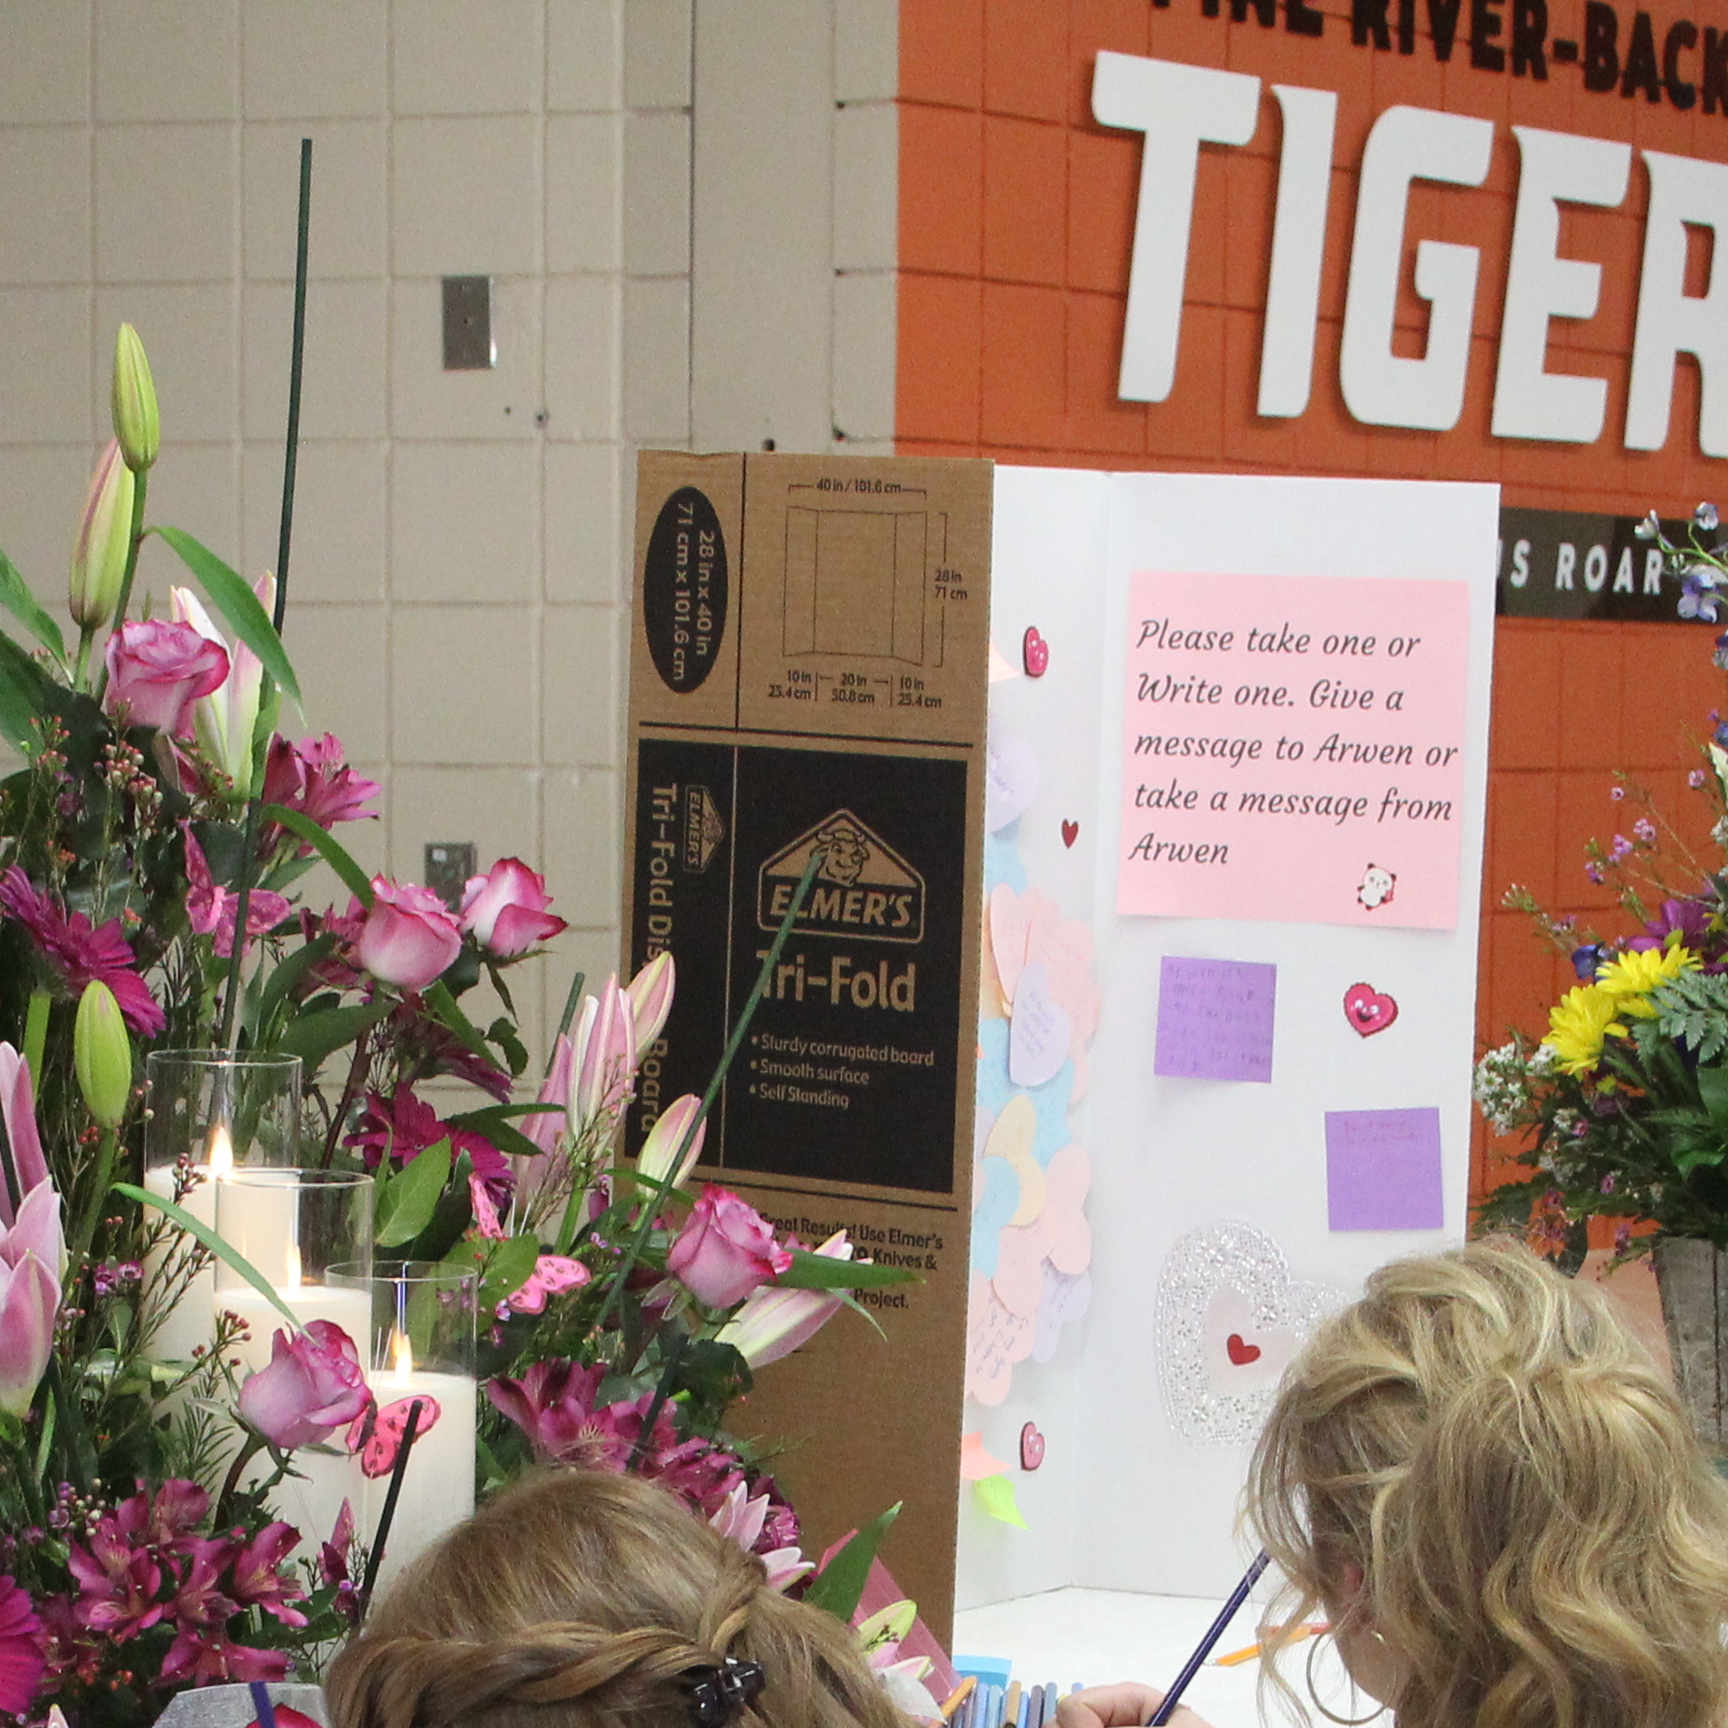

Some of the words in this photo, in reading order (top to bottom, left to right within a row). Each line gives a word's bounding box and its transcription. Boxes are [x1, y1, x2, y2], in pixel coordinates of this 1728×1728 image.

[677, 502, 695, 524] 71
[676, 532, 690, 565] cm
[698, 530, 715, 558] 28
[698, 561, 714, 581] in
[1496, 538, 1532, 588] S
[673, 588, 692, 644] 101.6
[696, 602, 713, 632] 40
[696, 634, 712, 656] in
[1136, 618, 1234, 651] Please
[1246, 622, 1311, 654] take
[1322, 632, 1376, 656] one
[1387, 635, 1421, 658] or
[673, 647, 686, 680] cm
[1137, 672, 1223, 704] Write
[1234, 682, 1295, 708] one.
[1309, 679, 1374, 710] Give
[1385, 688, 1404, 712] a
[1134, 732, 1263, 768] message
[1275, 736, 1305, 761] to
[1313, 733, 1413, 766] Arwen
[1424, 745, 1459, 769] or
[1134, 777, 1198, 810] take
[1209, 788, 1228, 812] a
[1238, 787, 1368, 826] message
[1376, 786, 1453, 824] from
[649, 783, 677, 906] Tri-Fold
[687, 791, 702, 866] ELMER'S
[1127, 832, 1229, 865] Arwen
[756, 949, 916, 1013] Tri-Fold
[761, 1033, 807, 1056] Sturdy
[809, 1041, 889, 1062] corrugated
[890, 1045, 934, 1067] board
[759, 1058, 814, 1078] Smooth
[816, 1065, 870, 1085] surface
[758, 1082, 785, 1101] Self
[787, 1086, 849, 1110] Standing
[859, 1223, 886, 1244] Use
[888, 1228, 943, 1250] Elmer's
[873, 1249, 922, 1268] Knives
[854, 1288, 909, 1310] Project.
